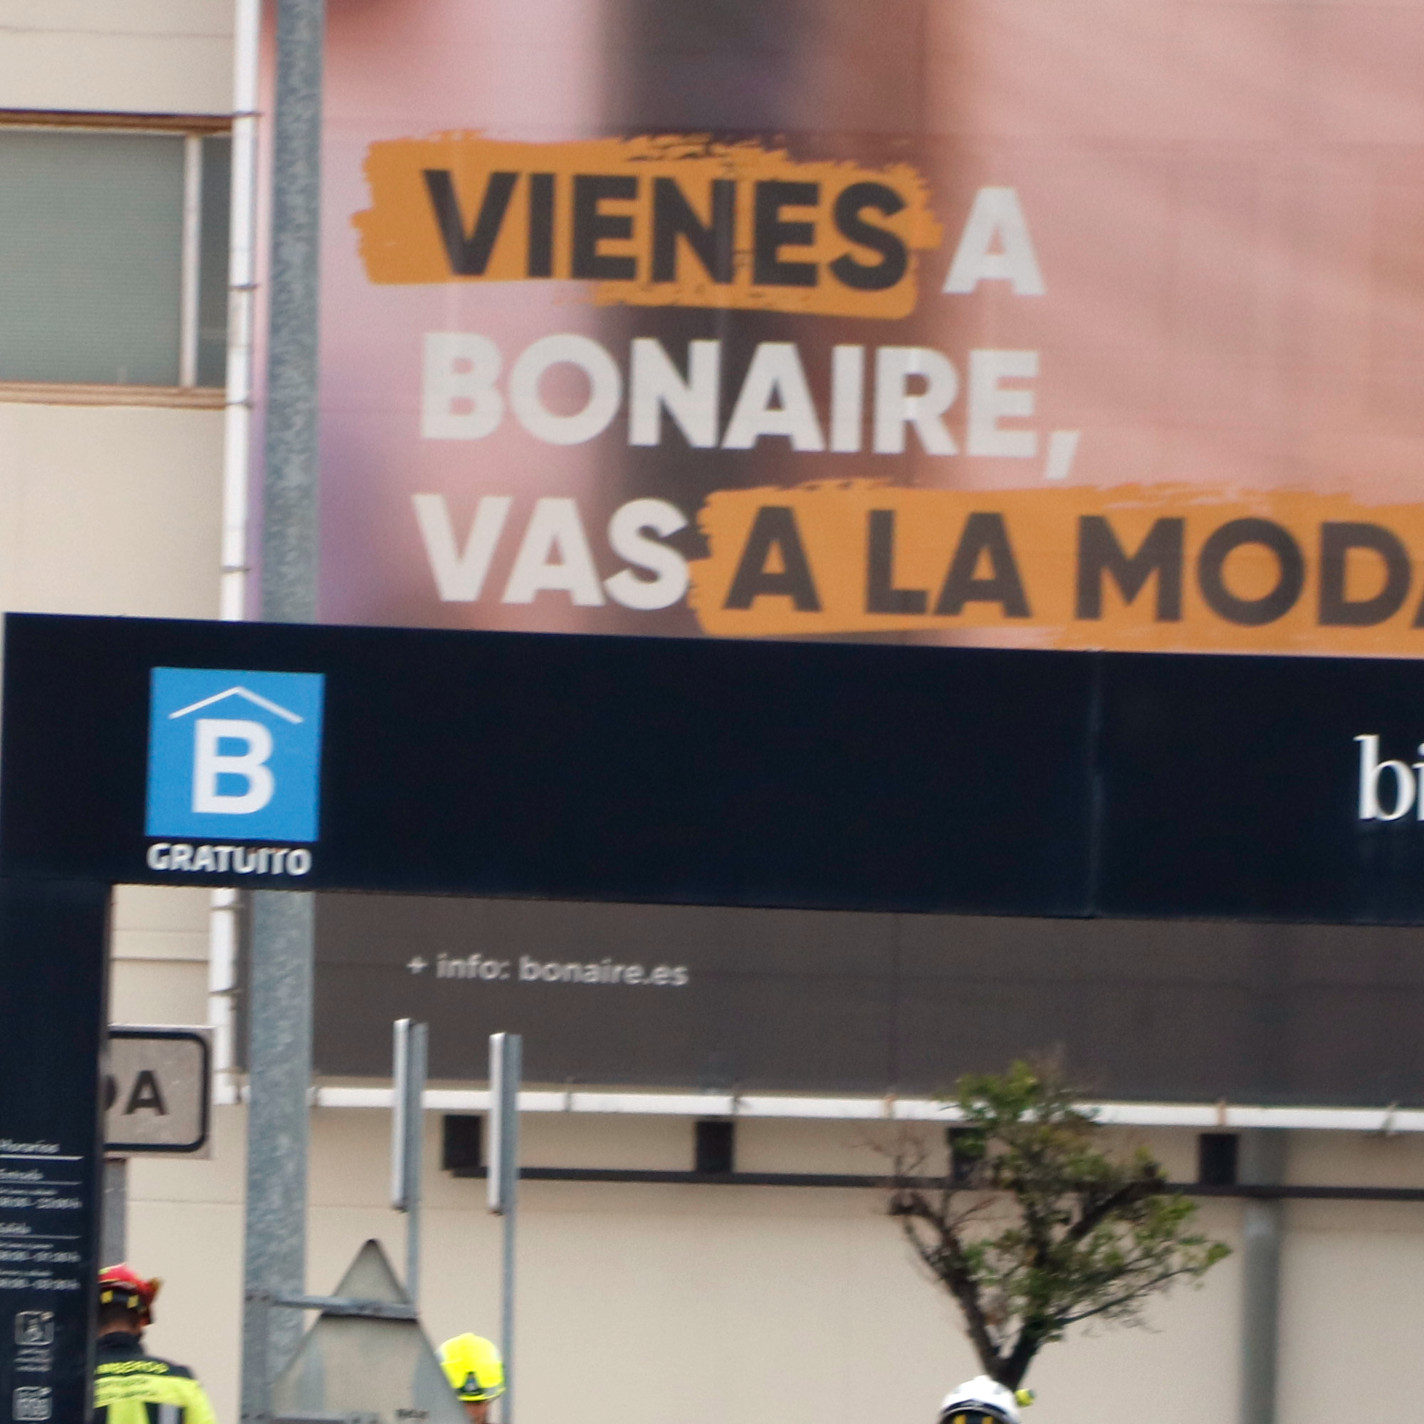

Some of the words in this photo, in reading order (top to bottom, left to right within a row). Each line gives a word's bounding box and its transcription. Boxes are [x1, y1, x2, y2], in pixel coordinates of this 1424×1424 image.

[421, 168, 910, 291] VIENES
[943, 186, 1044, 295] A
[419, 332, 1079, 478] BONAIRE,
[413, 494, 692, 611] VAS
[721, 505, 823, 613] A
[864, 509, 1032, 619] LA
[191, 718, 275, 814] B
[146, 843, 312, 876] GRATUITO
[436, 953, 510, 980] info:
[519, 955, 690, 986] bonaire.es
